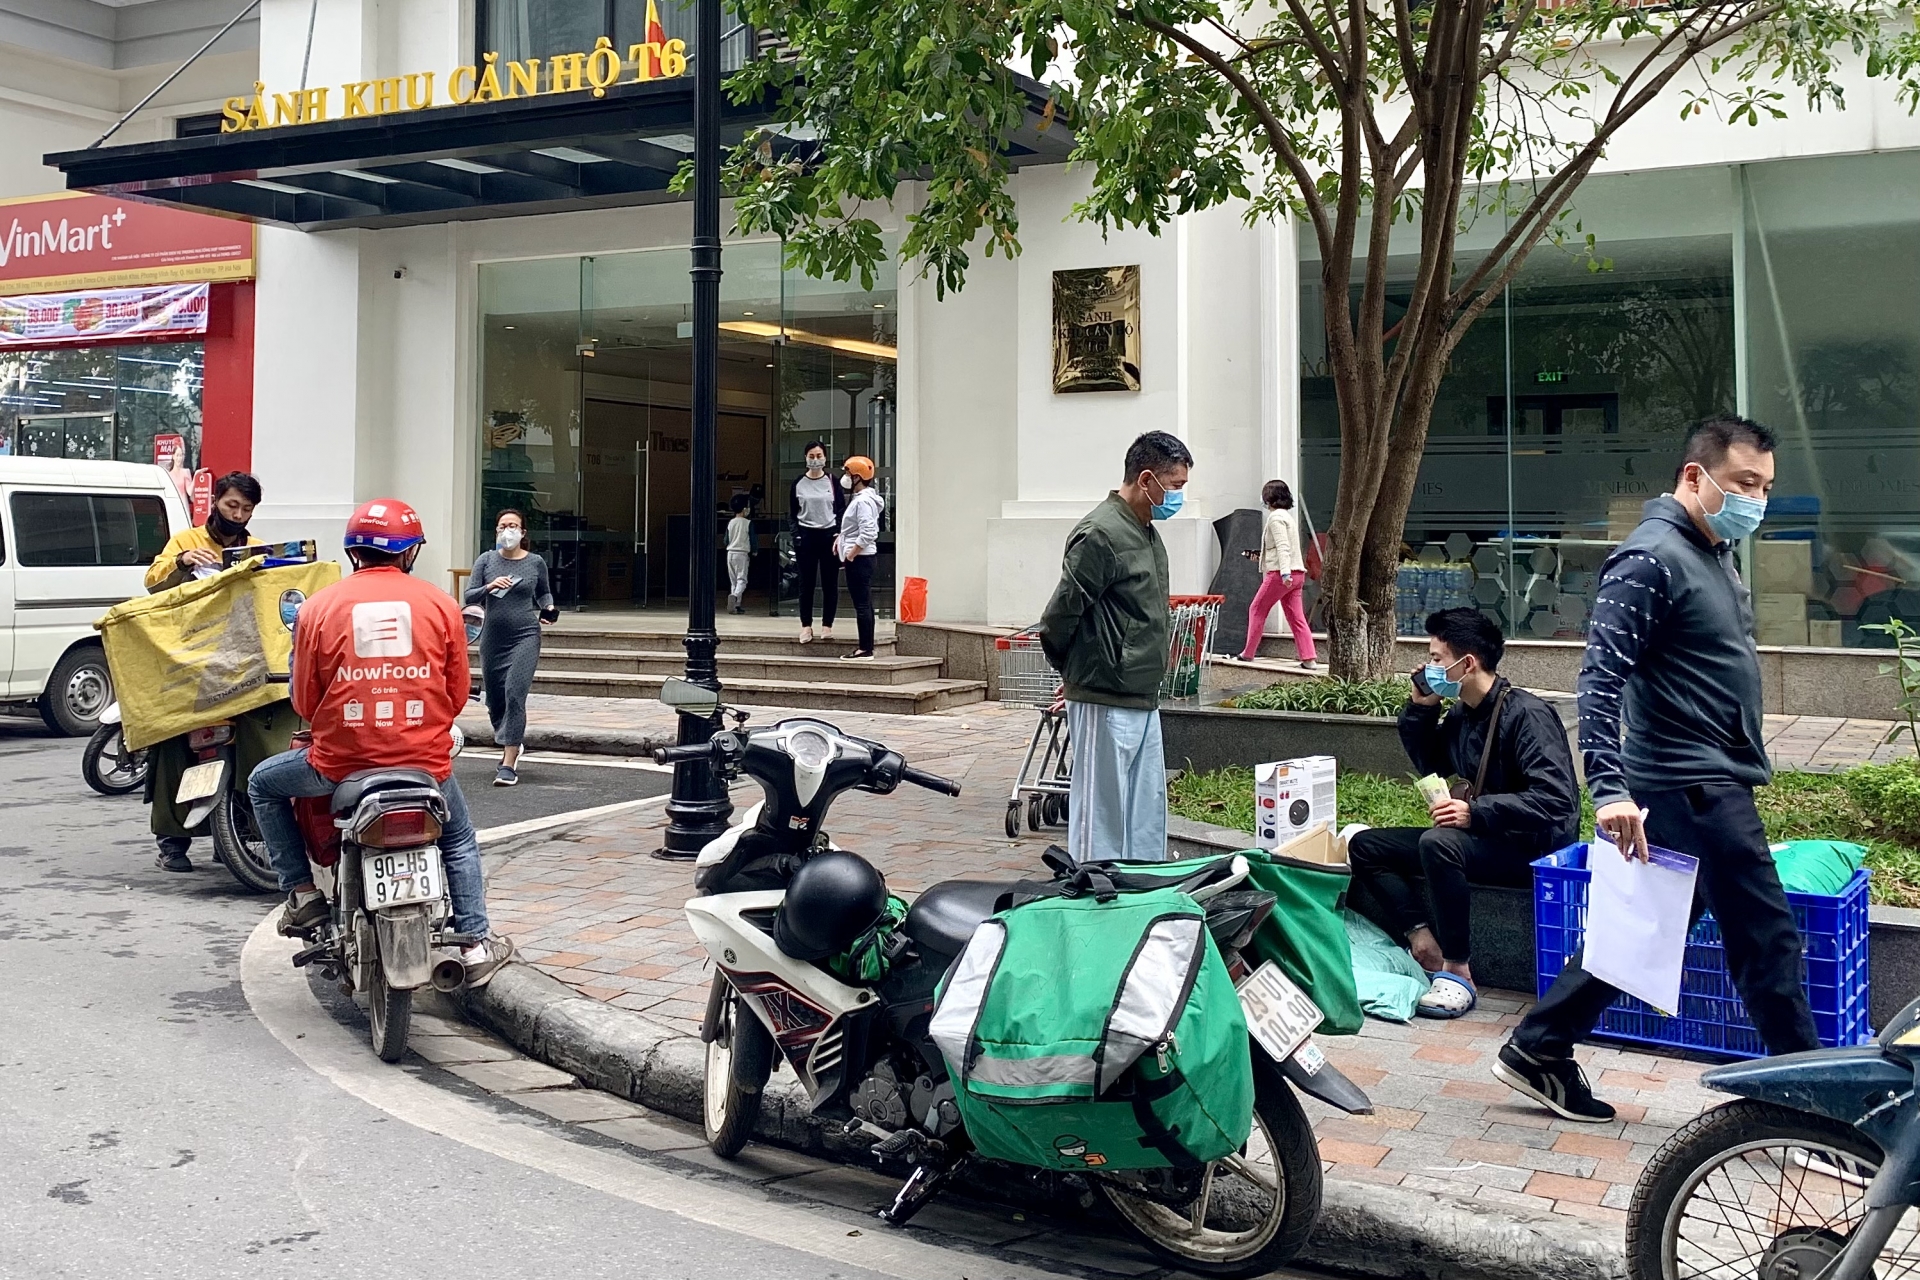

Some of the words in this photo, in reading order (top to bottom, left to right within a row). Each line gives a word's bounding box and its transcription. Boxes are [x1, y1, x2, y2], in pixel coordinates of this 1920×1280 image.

[221, 80, 330, 133] SẢNH
[341, 71, 436, 119] KHU
[448, 51, 541, 105] CĂN
[550, 36, 621, 98] HỘ
[629, 38, 687, 82] T6
[1538, 372, 1563, 382] EXIT
[358, 518, 389, 527] NowFood
[337, 662, 431, 683] NowFood
[206, 685, 240, 704] VIETNAM
[241, 675, 263, 689] POST
[371, 686, 382, 695] Có
[383, 686, 398, 694] trên
[343, 721, 365, 729] Shopee
[375, 720, 394, 728] Now
[374, 851, 428, 879] 90-H5
[376, 875, 431, 904] 9229
